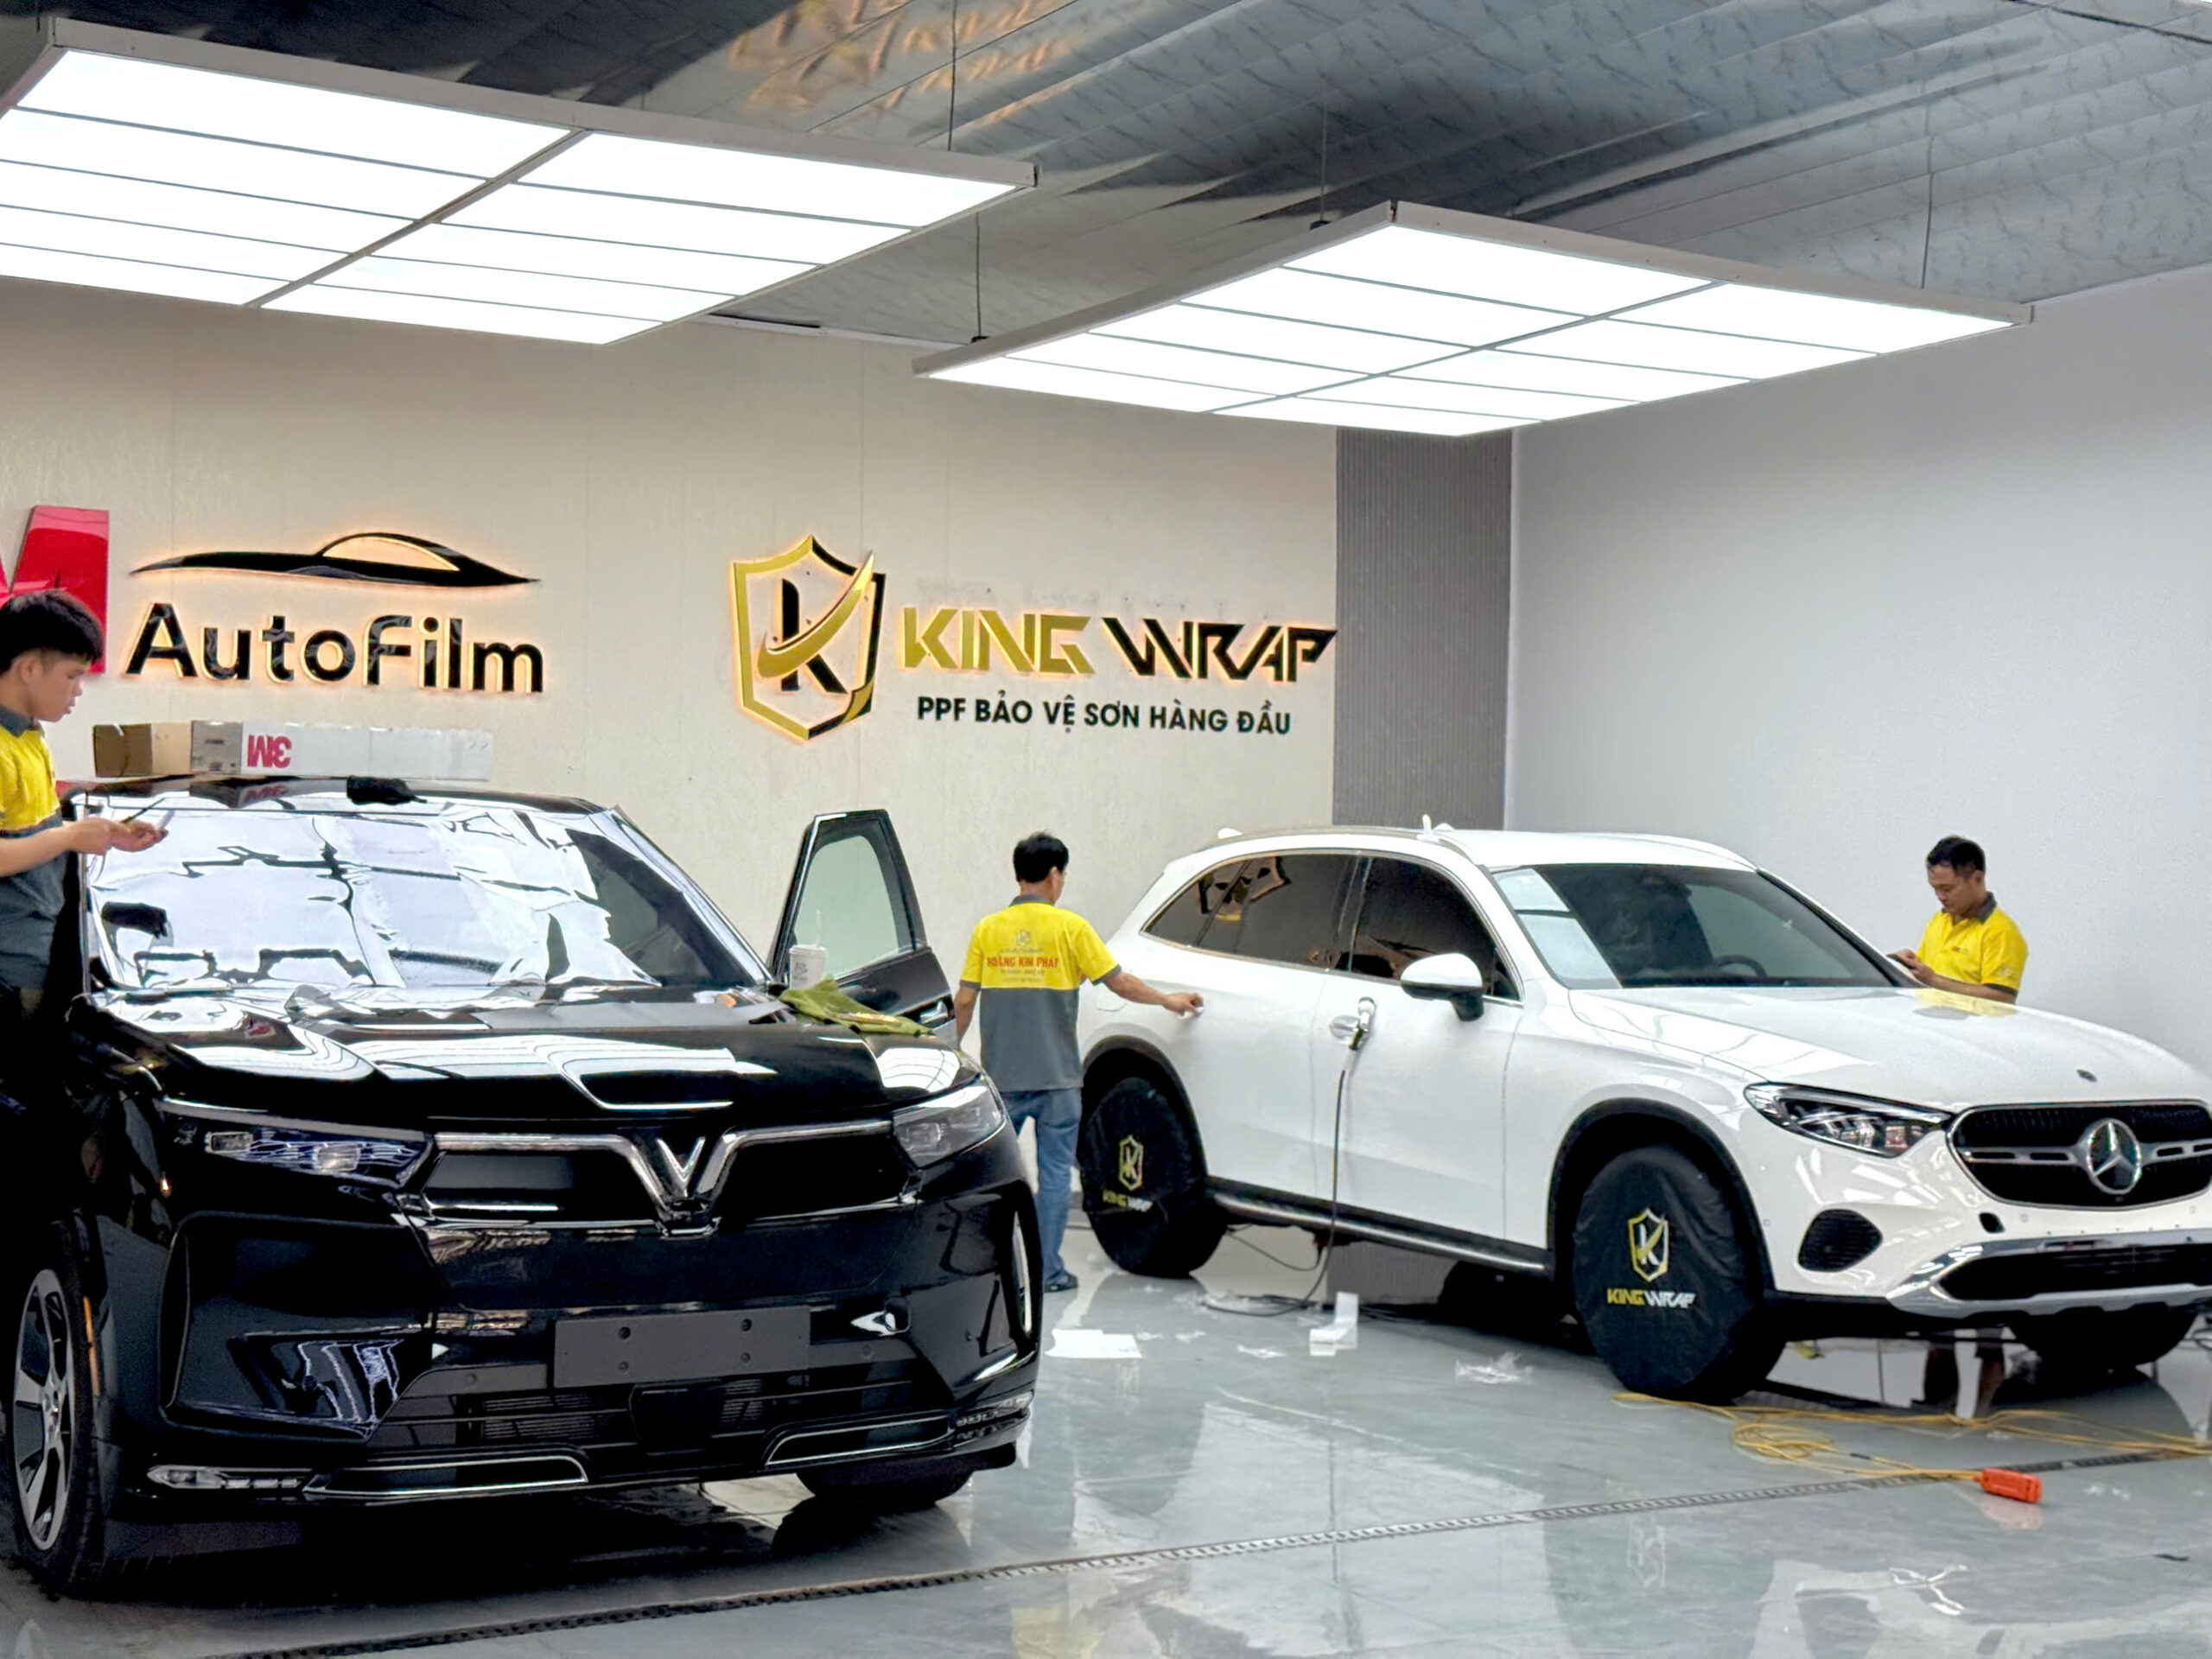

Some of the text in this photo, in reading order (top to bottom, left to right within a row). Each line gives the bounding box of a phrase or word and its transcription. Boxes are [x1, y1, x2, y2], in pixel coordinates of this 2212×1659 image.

[126, 602, 543, 692] AutoFilm
[904, 607, 1338, 682] KING WRAP
[918, 690, 1291, 734] PPF BẢO VỆ SƠN HÀNG ĐẦU
[247, 734, 292, 769] 3M
